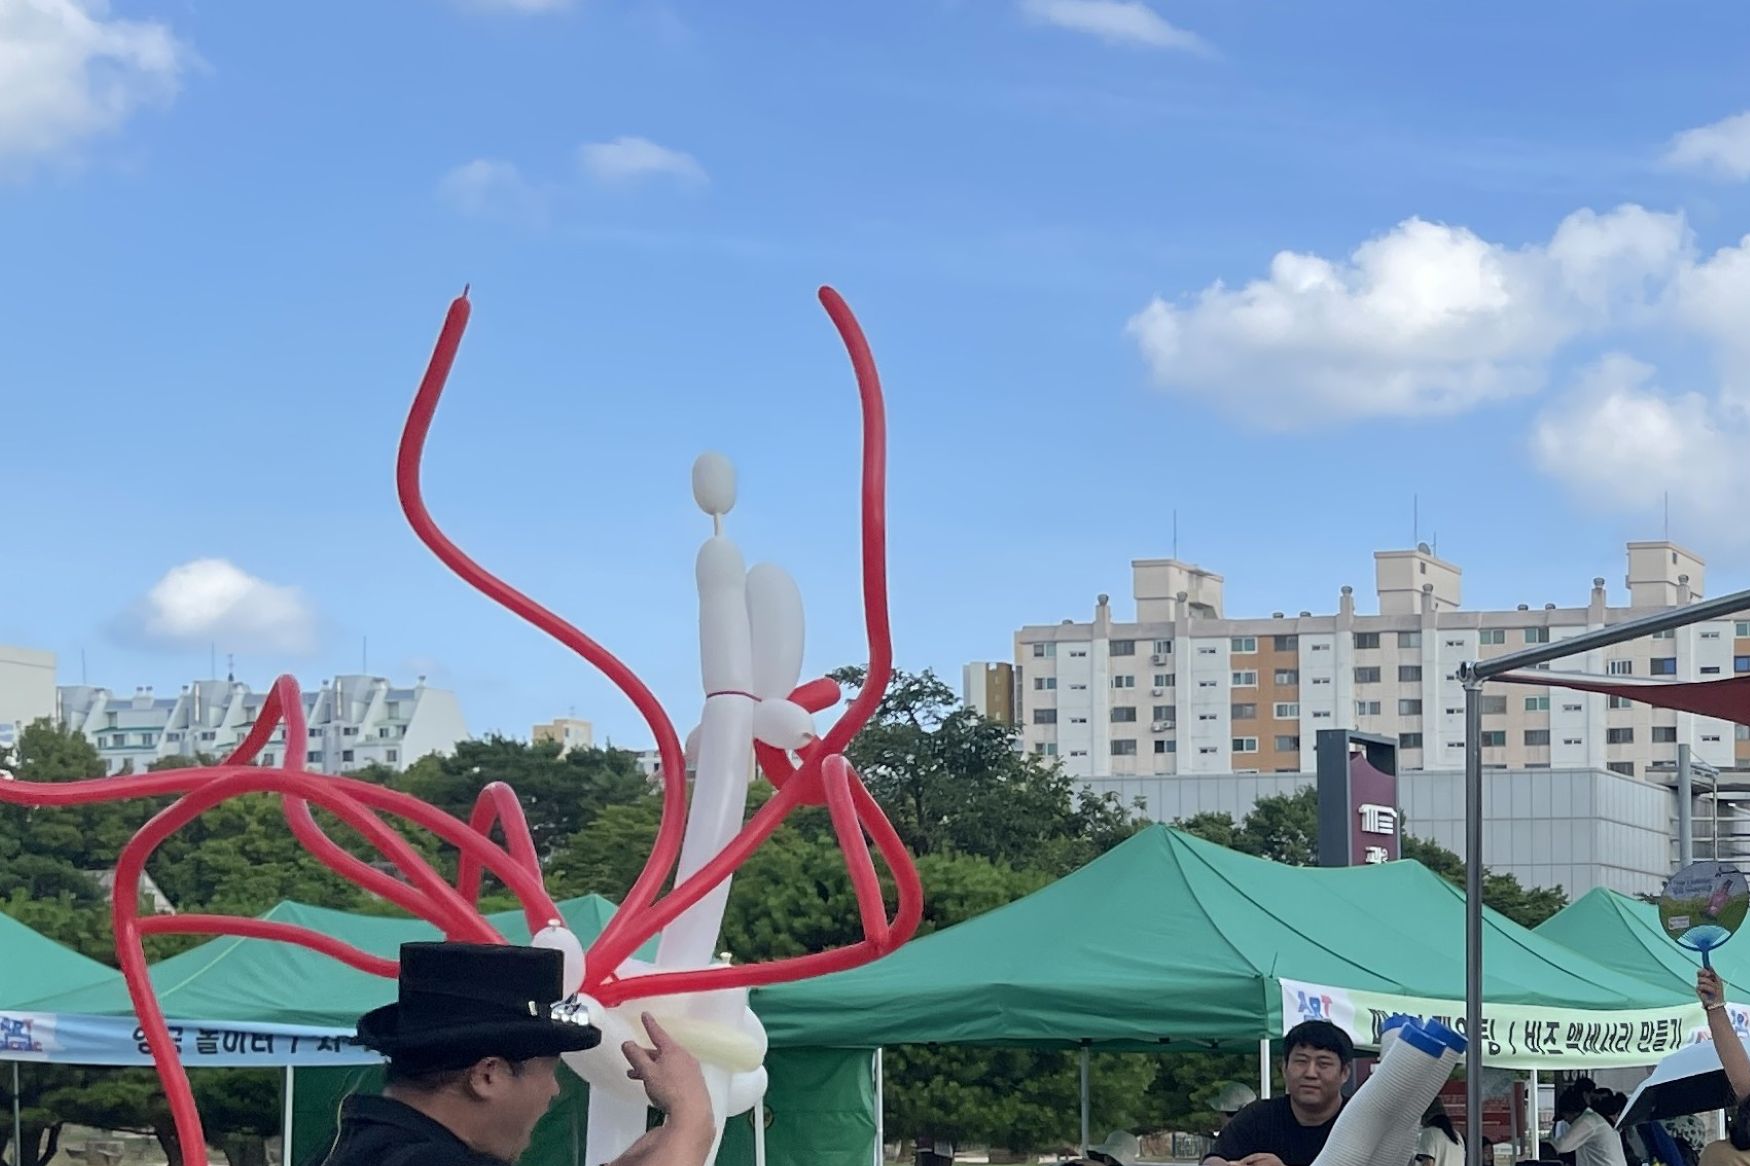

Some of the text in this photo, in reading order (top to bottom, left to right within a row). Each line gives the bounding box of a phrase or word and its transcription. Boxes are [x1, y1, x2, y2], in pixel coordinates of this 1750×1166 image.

[196, 1027, 274, 1055] 놀이터
[1524, 1020, 1564, 1055] 비즈
[1566, 1022, 1634, 1055] 액세서리
[1637, 1017, 1683, 1053] 만들기
